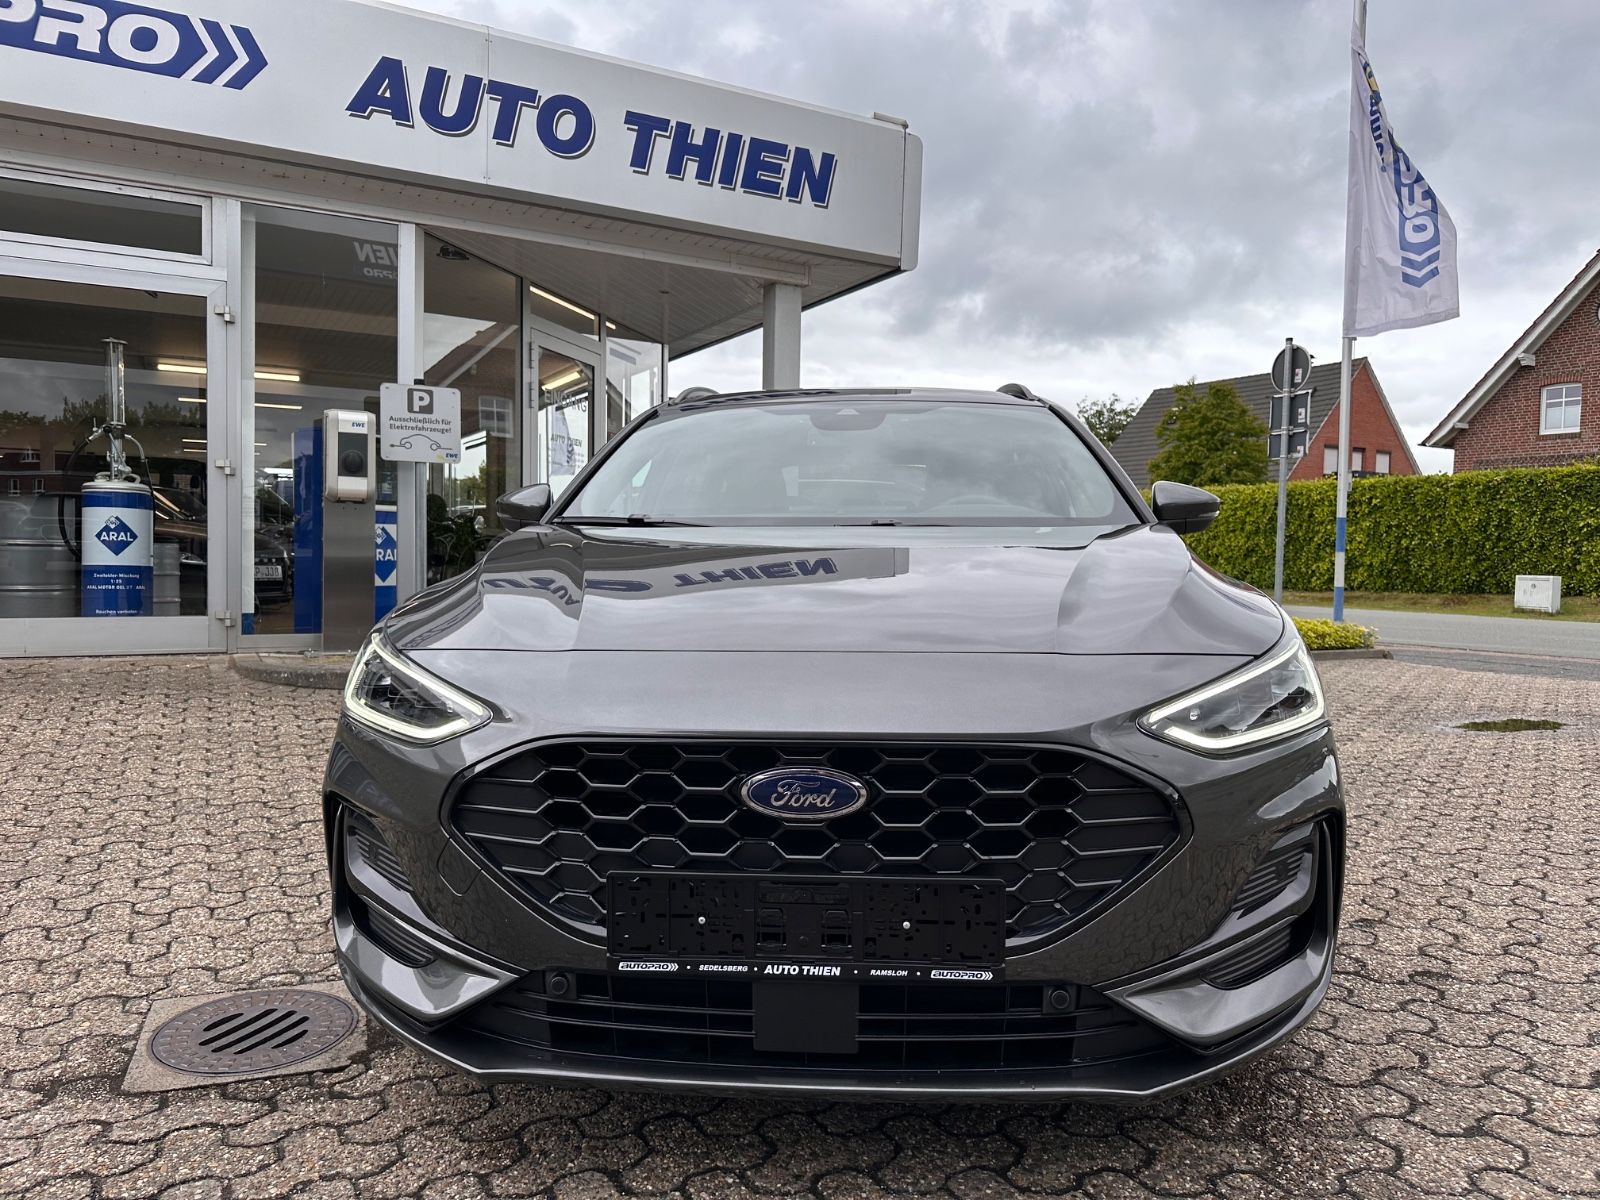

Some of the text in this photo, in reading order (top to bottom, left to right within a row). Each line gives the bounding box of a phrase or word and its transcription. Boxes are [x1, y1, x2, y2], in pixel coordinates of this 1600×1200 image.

[346, 55, 838, 208] AUTO THIEN
[412, 390, 431, 412] P
[389, 415, 452, 426] Ausschließlich für
[389, 423, 452, 434] Elektrofahrzeuge!
[100, 531, 134, 541] ARAL
[770, 779, 837, 808] Ford
[698, 964, 749, 973] SEDELSBERG
[763, 964, 800, 975] AUTO
[801, 965, 841, 977] THIEN
[870, 969, 909, 977] RAMSLOH
